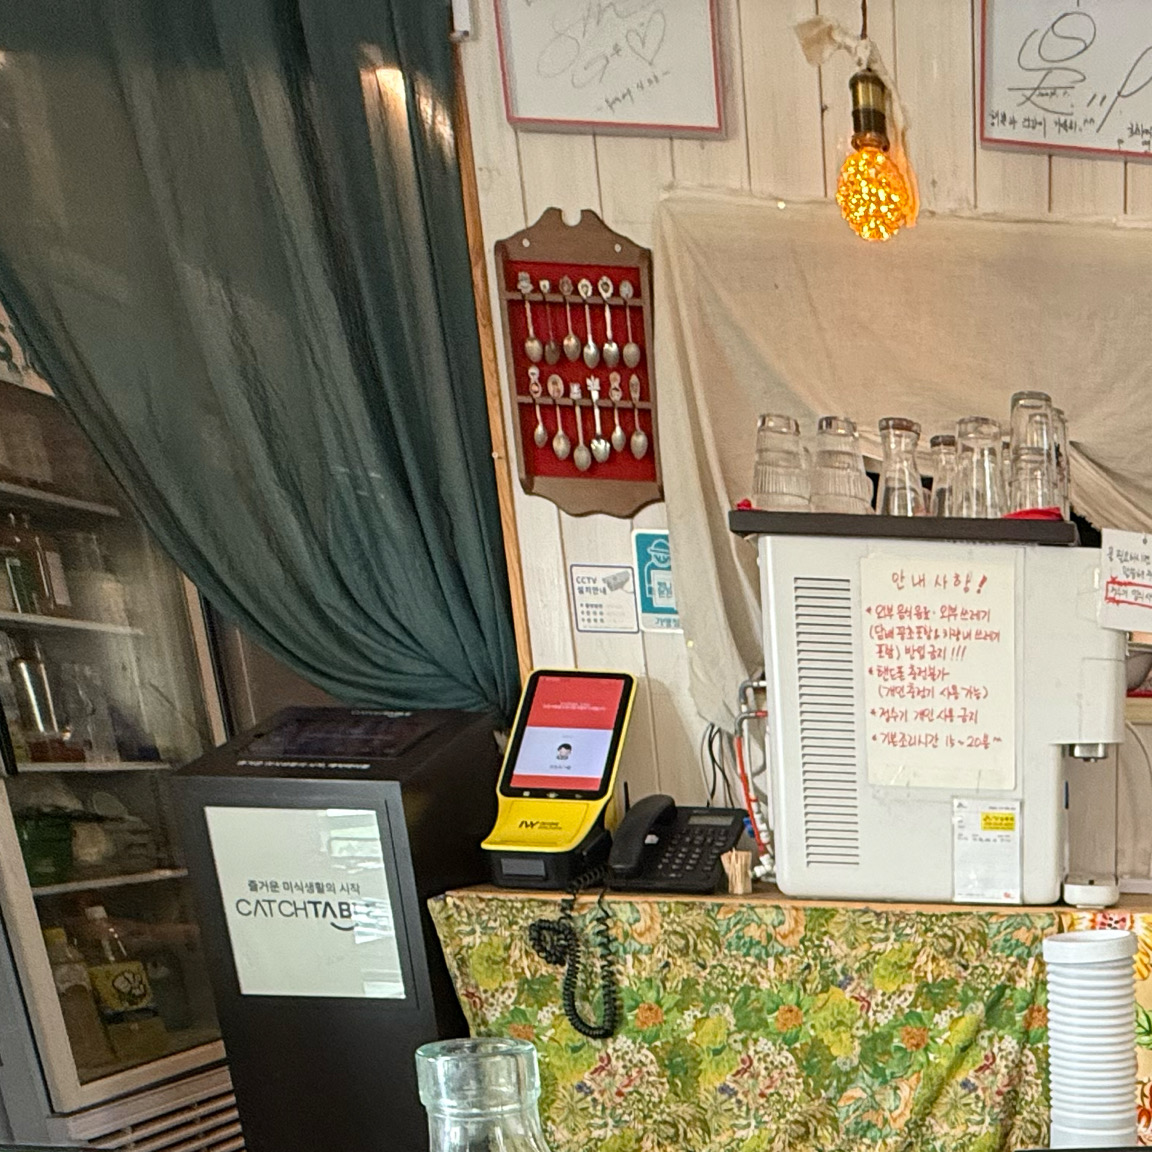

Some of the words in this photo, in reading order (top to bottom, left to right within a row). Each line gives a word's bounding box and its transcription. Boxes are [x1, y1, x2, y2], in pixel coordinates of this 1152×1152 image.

[576, 575, 597, 584] CCTV
[879, 707, 908, 723] 정수기
[247, 880, 280, 893] 즐거운
[282, 881, 336, 894] 미식생활의
[340, 882, 361, 895] 시작
